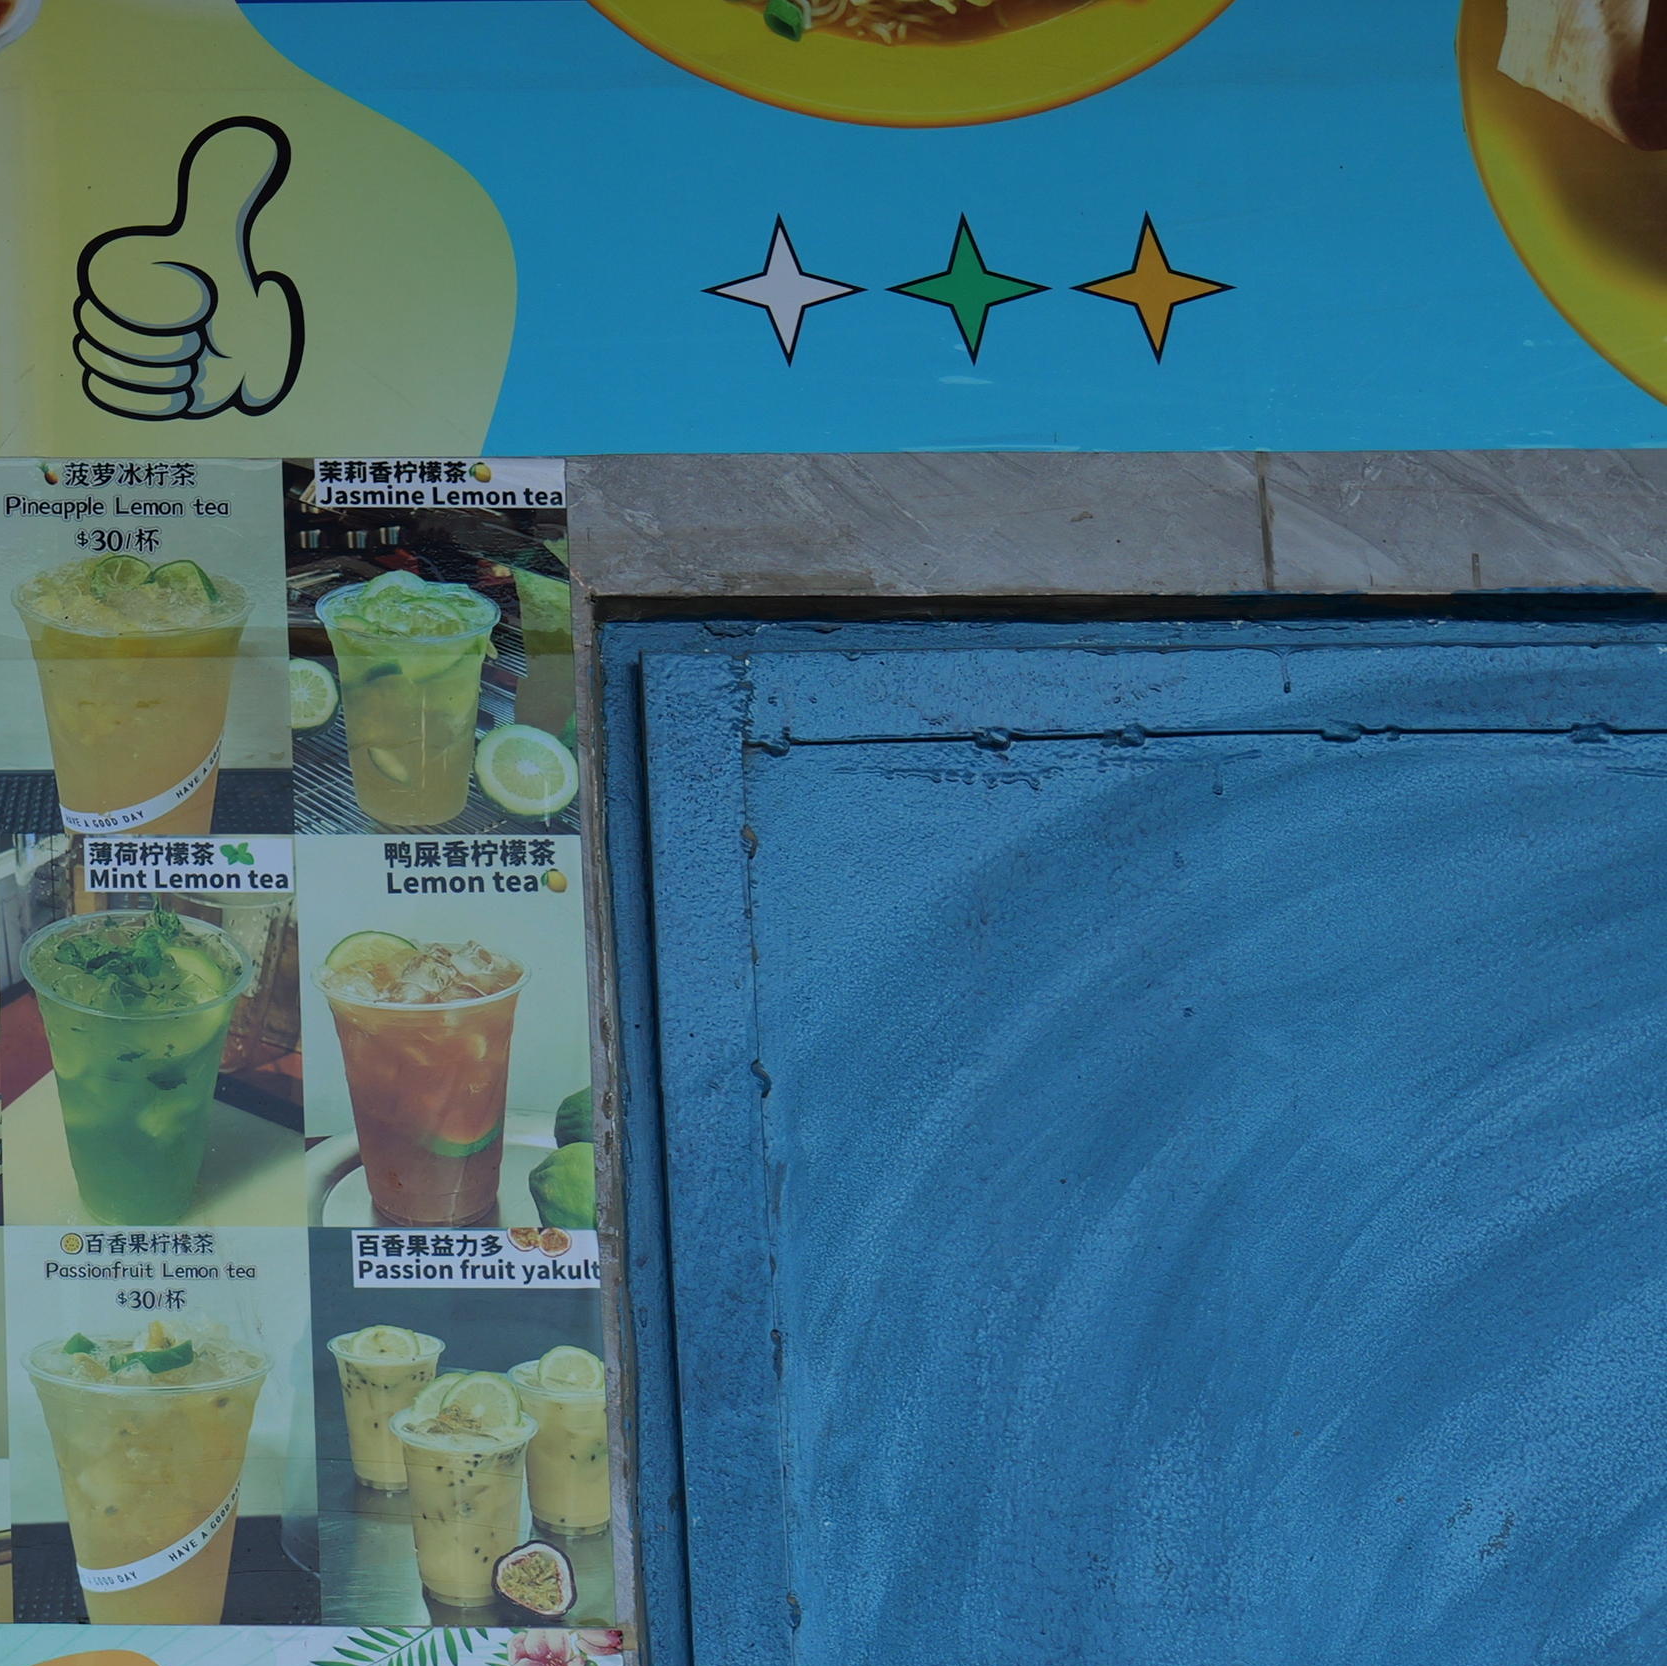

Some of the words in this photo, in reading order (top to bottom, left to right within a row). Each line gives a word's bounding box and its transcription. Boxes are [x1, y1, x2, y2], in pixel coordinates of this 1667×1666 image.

[65, 462, 195, 487] 菠萝冰柠茶
[319, 461, 466, 484] 茉莉香柠檬茶
[319, 485, 424, 506] Jasmine
[433, 487, 516, 505] Lemon
[523, 487, 563, 506] tea
[5, 497, 104, 519] Pineapple
[116, 497, 183, 516] Lemon
[194, 498, 229, 515] tea
[175, 778, 200, 798] HAVE
[92, 818, 118, 829] GOOD
[123, 810, 144, 824] DAY
[89, 842, 214, 866] 薄荷柠檬茶
[384, 839, 555, 868] 鸭屎香柠檬茶
[90, 868, 147, 888] Mint
[155, 869, 240, 888] Lemon
[247, 870, 289, 888] tea
[387, 871, 484, 894] Lemon
[493, 872, 538, 893] tea
[86, 1233, 213, 1254] 百香果柠檬茶
[357, 1234, 503, 1257] 百香果益力多
[46, 1261, 154, 1278] Passionfruit
[162, 1261, 218, 1278] Lemon
[227, 1264, 256, 1278] tea
[358, 1259, 453, 1280] Passion
[460, 1259, 515, 1280] fruit
[522, 1259, 600, 1284] yakult
[168, 1538, 198, 1562] HAVE
[210, 1503, 230, 1529] GOOD
[118, 1570, 138, 1583] DAY
